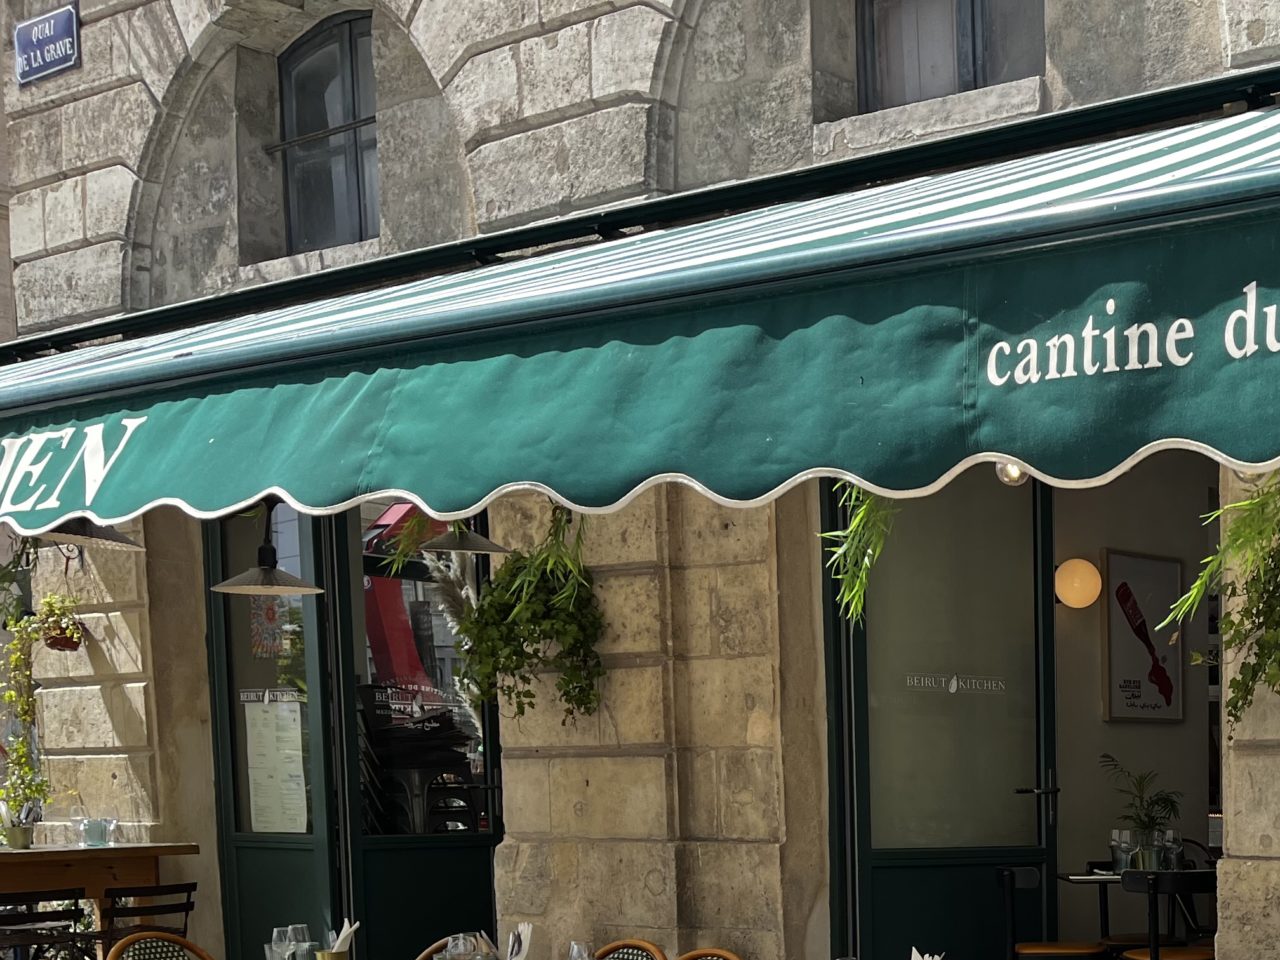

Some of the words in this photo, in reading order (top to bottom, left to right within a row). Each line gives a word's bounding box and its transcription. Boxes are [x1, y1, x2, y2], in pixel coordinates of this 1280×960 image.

[32, 20, 54, 45] QUAI
[18, 55, 29, 73] DE
[31, 50, 43, 68] LA
[45, 38, 73, 62] GRAVE
[985, 298, 1195, 387] cantine
[906, 676, 947, 688] BEIRUT
[959, 678, 1006, 690] KITCHEN
[375, 692, 413, 701] BEIRUT
